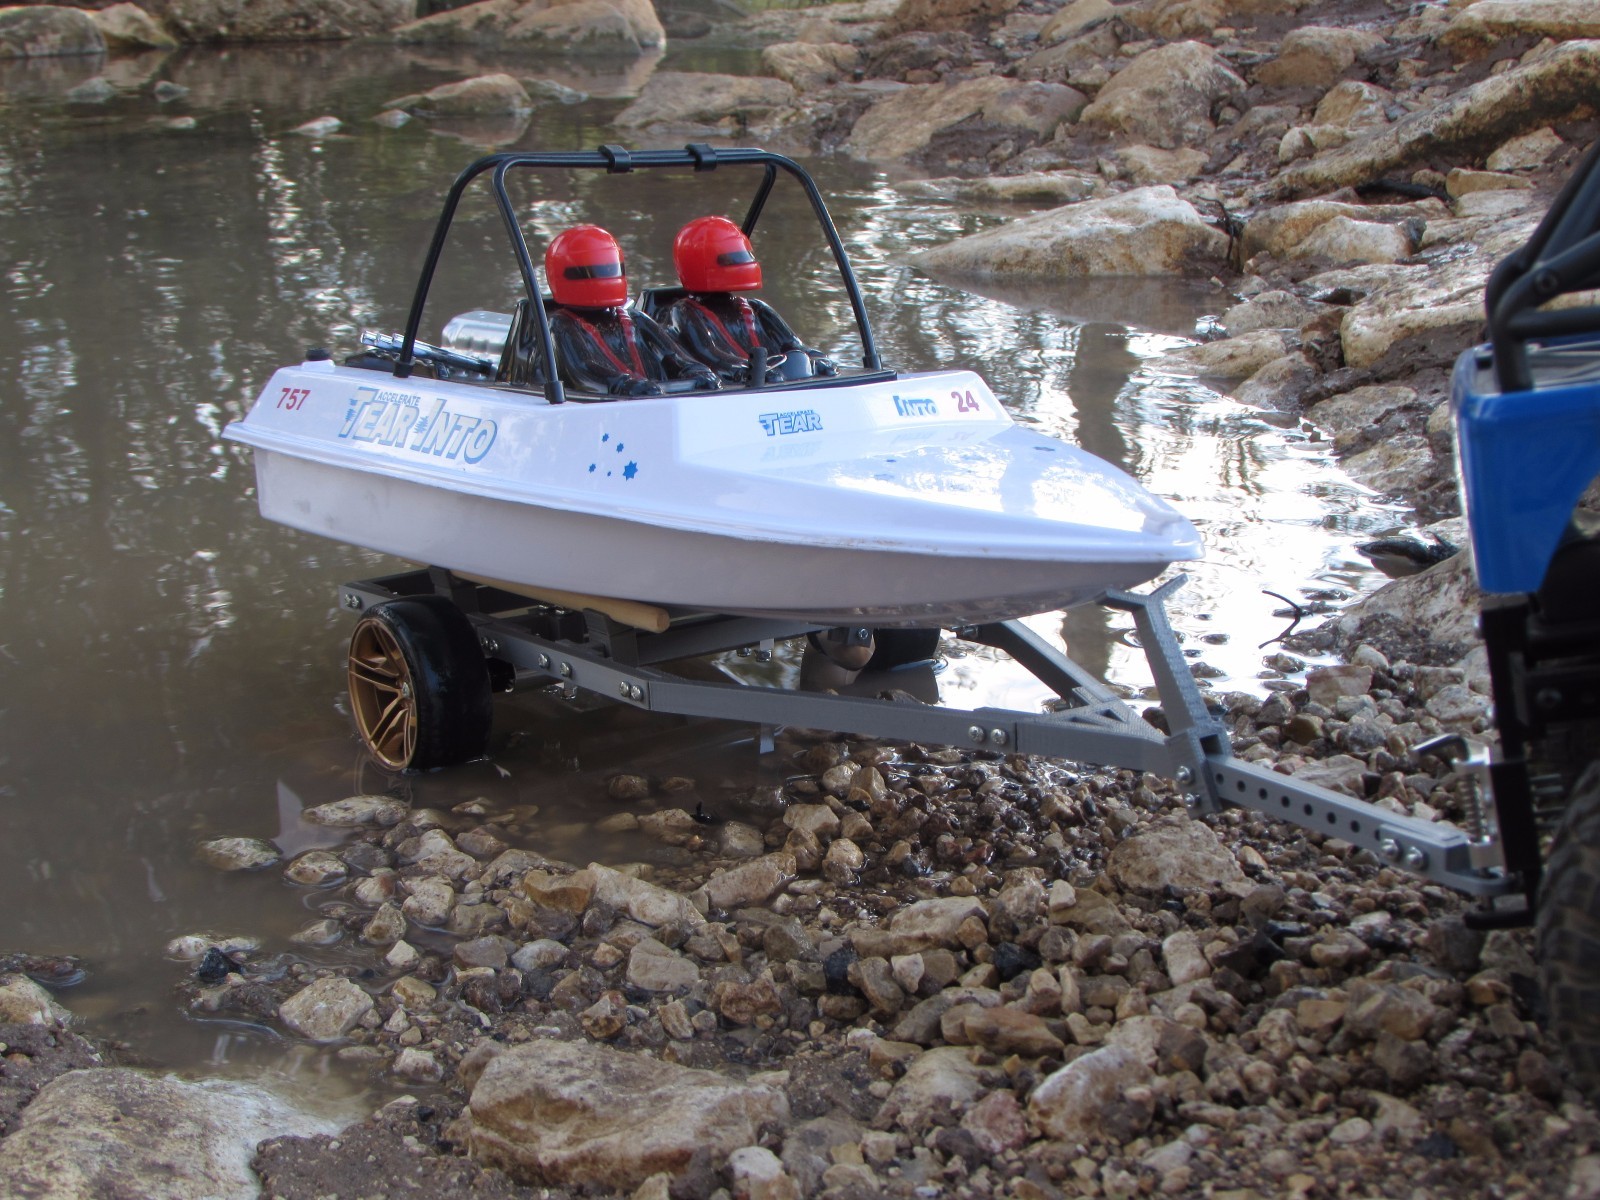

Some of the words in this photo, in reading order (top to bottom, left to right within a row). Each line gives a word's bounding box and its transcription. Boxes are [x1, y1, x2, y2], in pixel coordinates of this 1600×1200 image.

[276, 387, 311, 411] 757
[377, 392, 421, 407] ACCELERATE
[892, 395, 939, 418] INTO
[950, 390, 980, 413] 24
[758, 411, 824, 437] TEAR
[778, 409, 814, 418] ACCELERATE
[338, 386, 420, 449] TEAR
[409, 398, 498, 465] INTO
